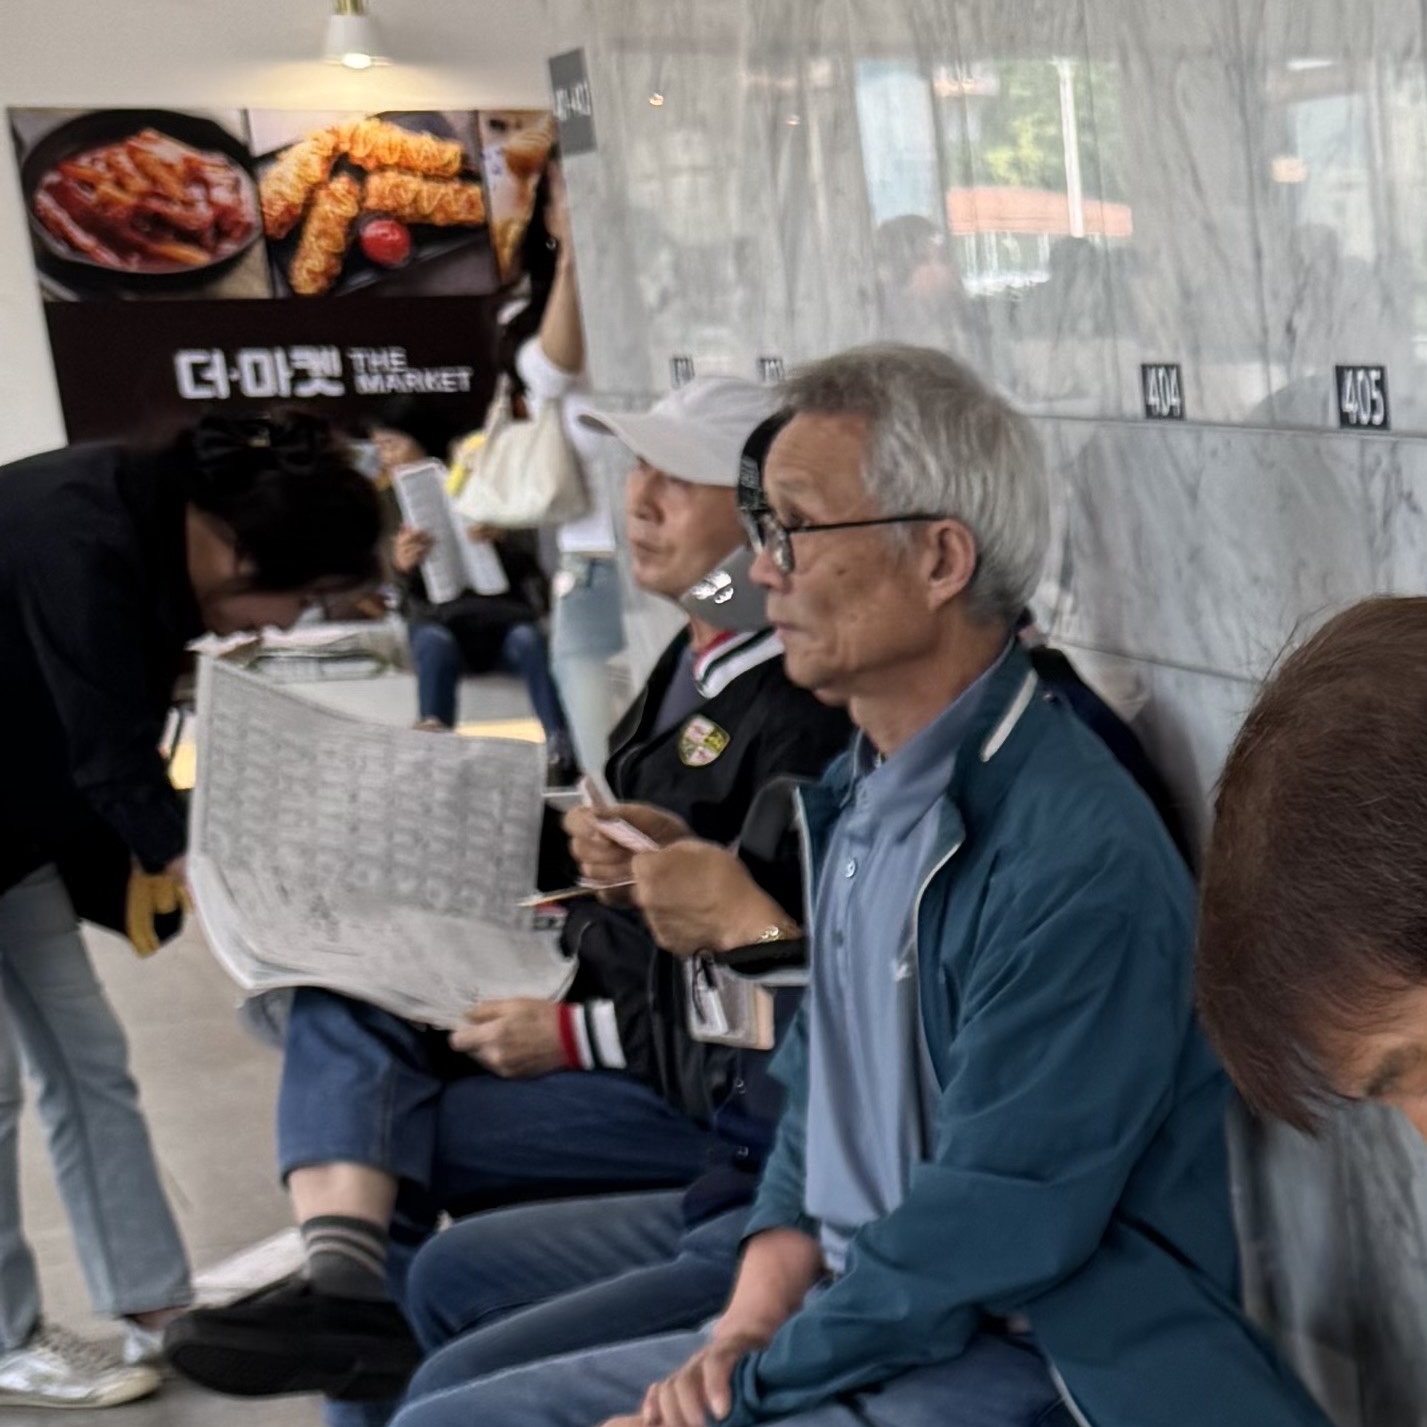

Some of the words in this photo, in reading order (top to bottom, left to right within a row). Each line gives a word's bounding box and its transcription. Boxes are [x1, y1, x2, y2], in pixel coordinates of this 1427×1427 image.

[349, 347, 408, 373] THE
[355, 367, 473, 395] MARKET
[1148, 366, 1181, 417] 404
[1342, 370, 1385, 425] 405
